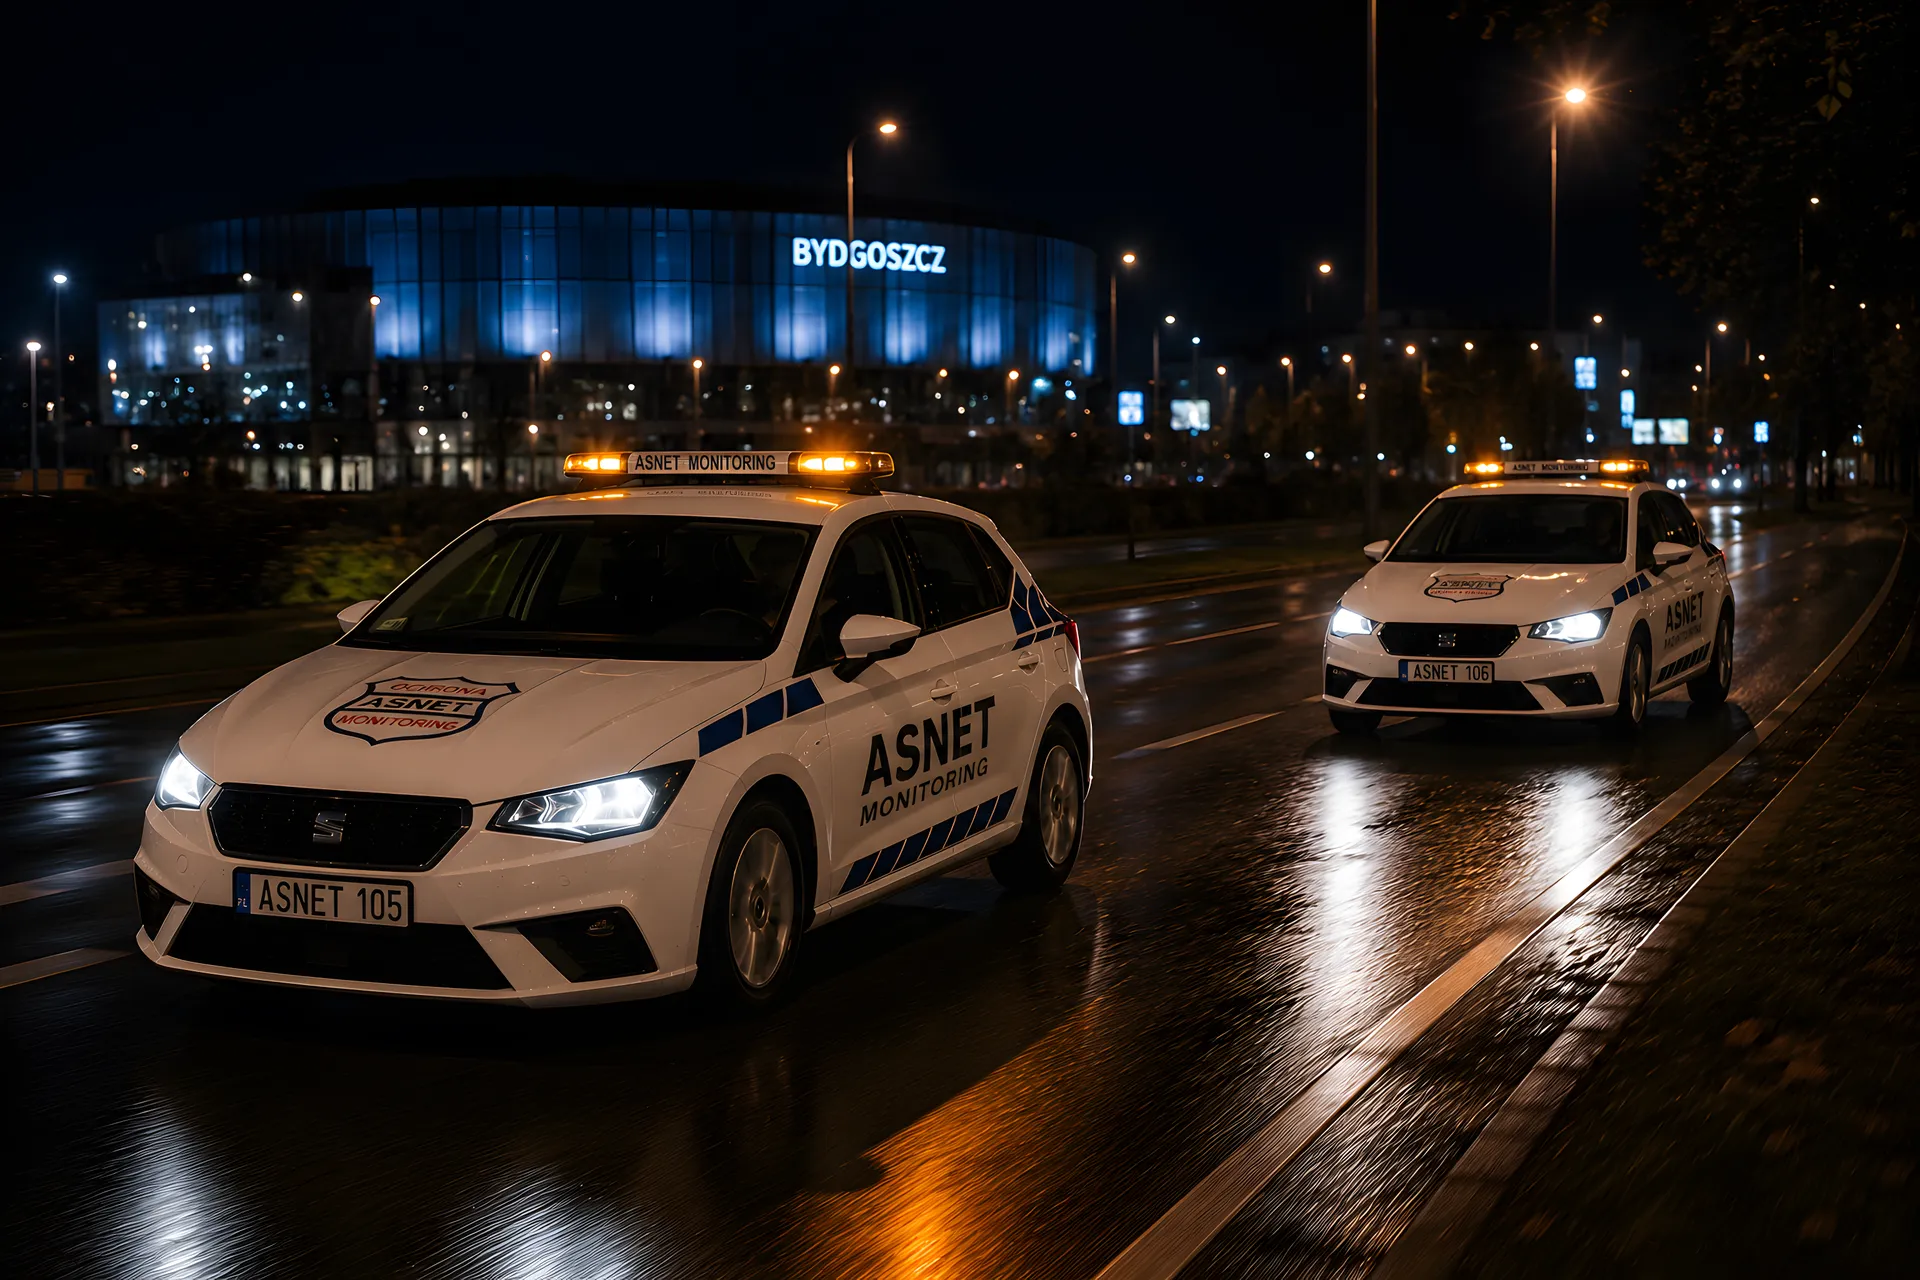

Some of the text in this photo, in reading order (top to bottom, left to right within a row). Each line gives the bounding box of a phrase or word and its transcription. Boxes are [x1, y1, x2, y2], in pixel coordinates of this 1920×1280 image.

[793, 237, 947, 274] BYDGOSZCZ
[635, 454, 776, 471] ASNET MONITORING
[1665, 590, 1704, 634] ASNET
[1413, 663, 1489, 681] ASNET 106
[390, 683, 487, 696] OCHRONA
[358, 697, 473, 712] ASNET
[336, 714, 459, 731] MONITORING
[861, 695, 996, 796] ASNET
[859, 756, 988, 827] MONITORING
[258, 879, 402, 922] ASNET 105
